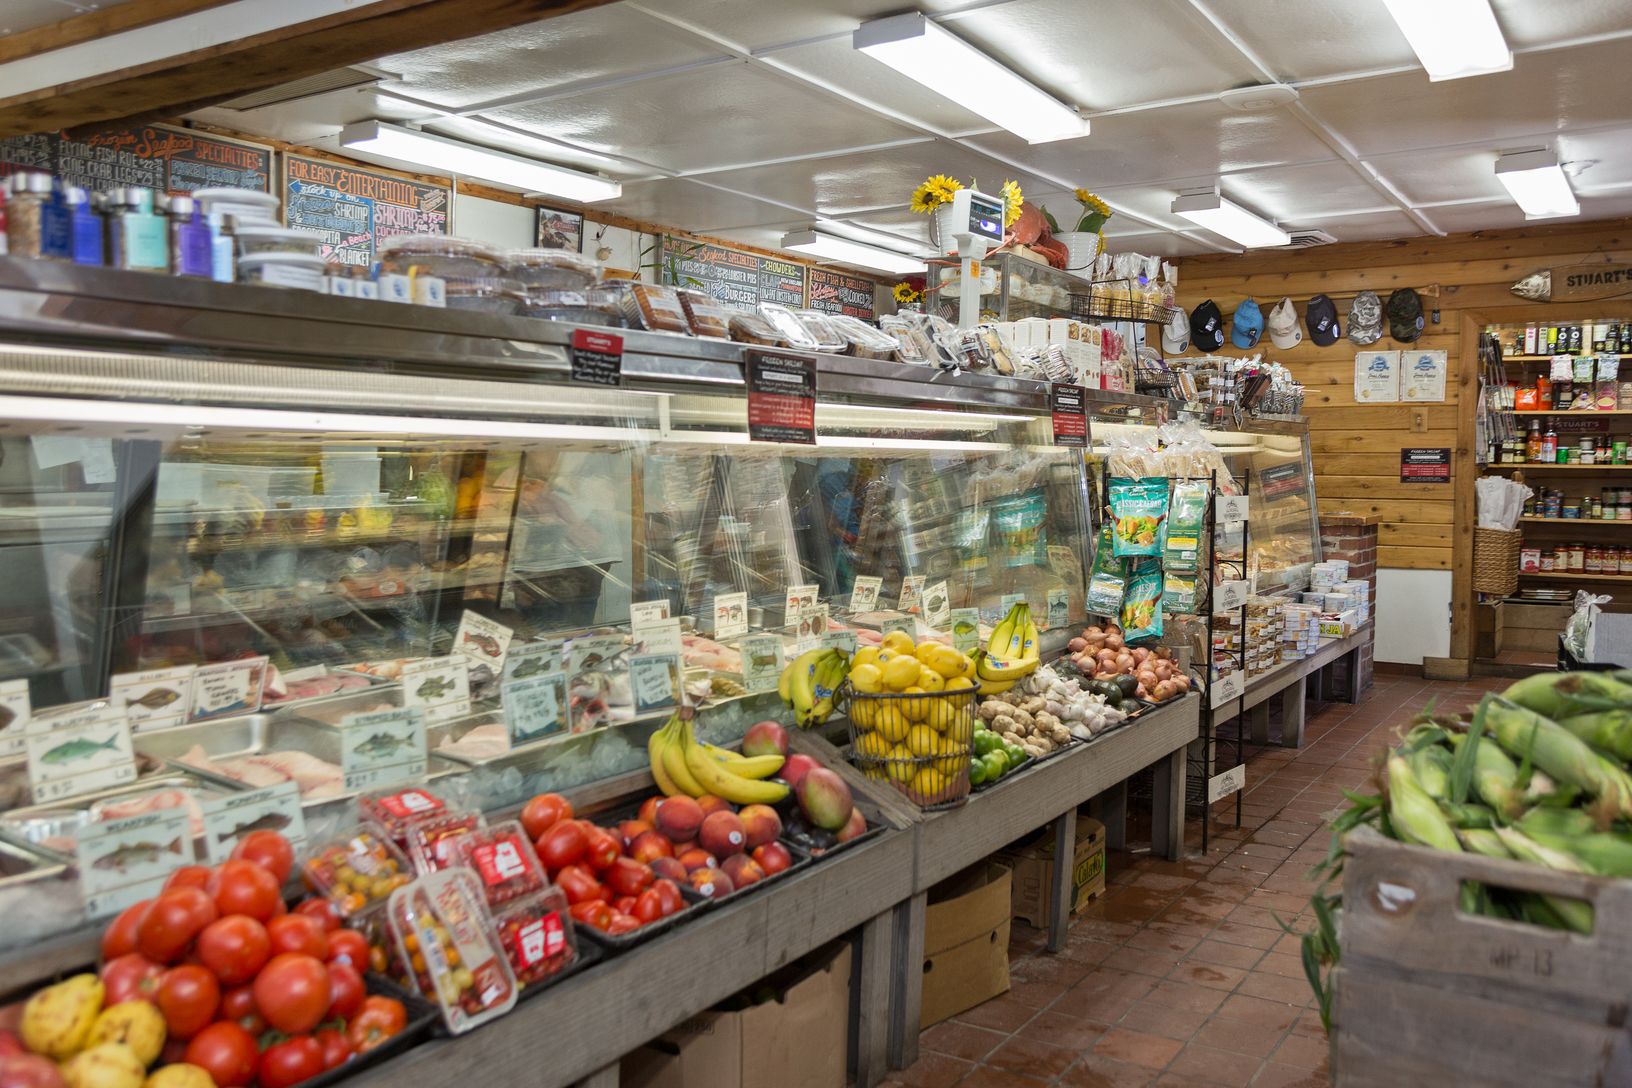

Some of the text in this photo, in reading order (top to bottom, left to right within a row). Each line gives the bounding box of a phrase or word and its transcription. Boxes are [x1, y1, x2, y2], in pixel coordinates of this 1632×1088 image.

[59, 139, 95, 159] FLYING
[96, 146, 118, 163] FISH
[133, 128, 193, 159] Seafood
[59, 156, 85, 174] KING
[87, 161, 113, 179] CRAB
[114, 166, 138, 184] LEGS
[289, 160, 418, 206] FOR EASY ENTERTAINING
[328, 191, 343, 201] up
[334, 202, 369, 221] SHRIMP
[374, 204, 418, 229] SHRIMP
[347, 231, 372, 245] Beach
[339, 247, 370, 266] BLANKET
[698, 247, 727, 265] Seafood
[765, 260, 796, 276] CHOWDERS
[811, 269, 827, 282] FRESH
[827, 273, 839, 285] FISH
[1567, 268, 1632, 287] STUART'S
[724, 283, 757, 304] BURGERS
